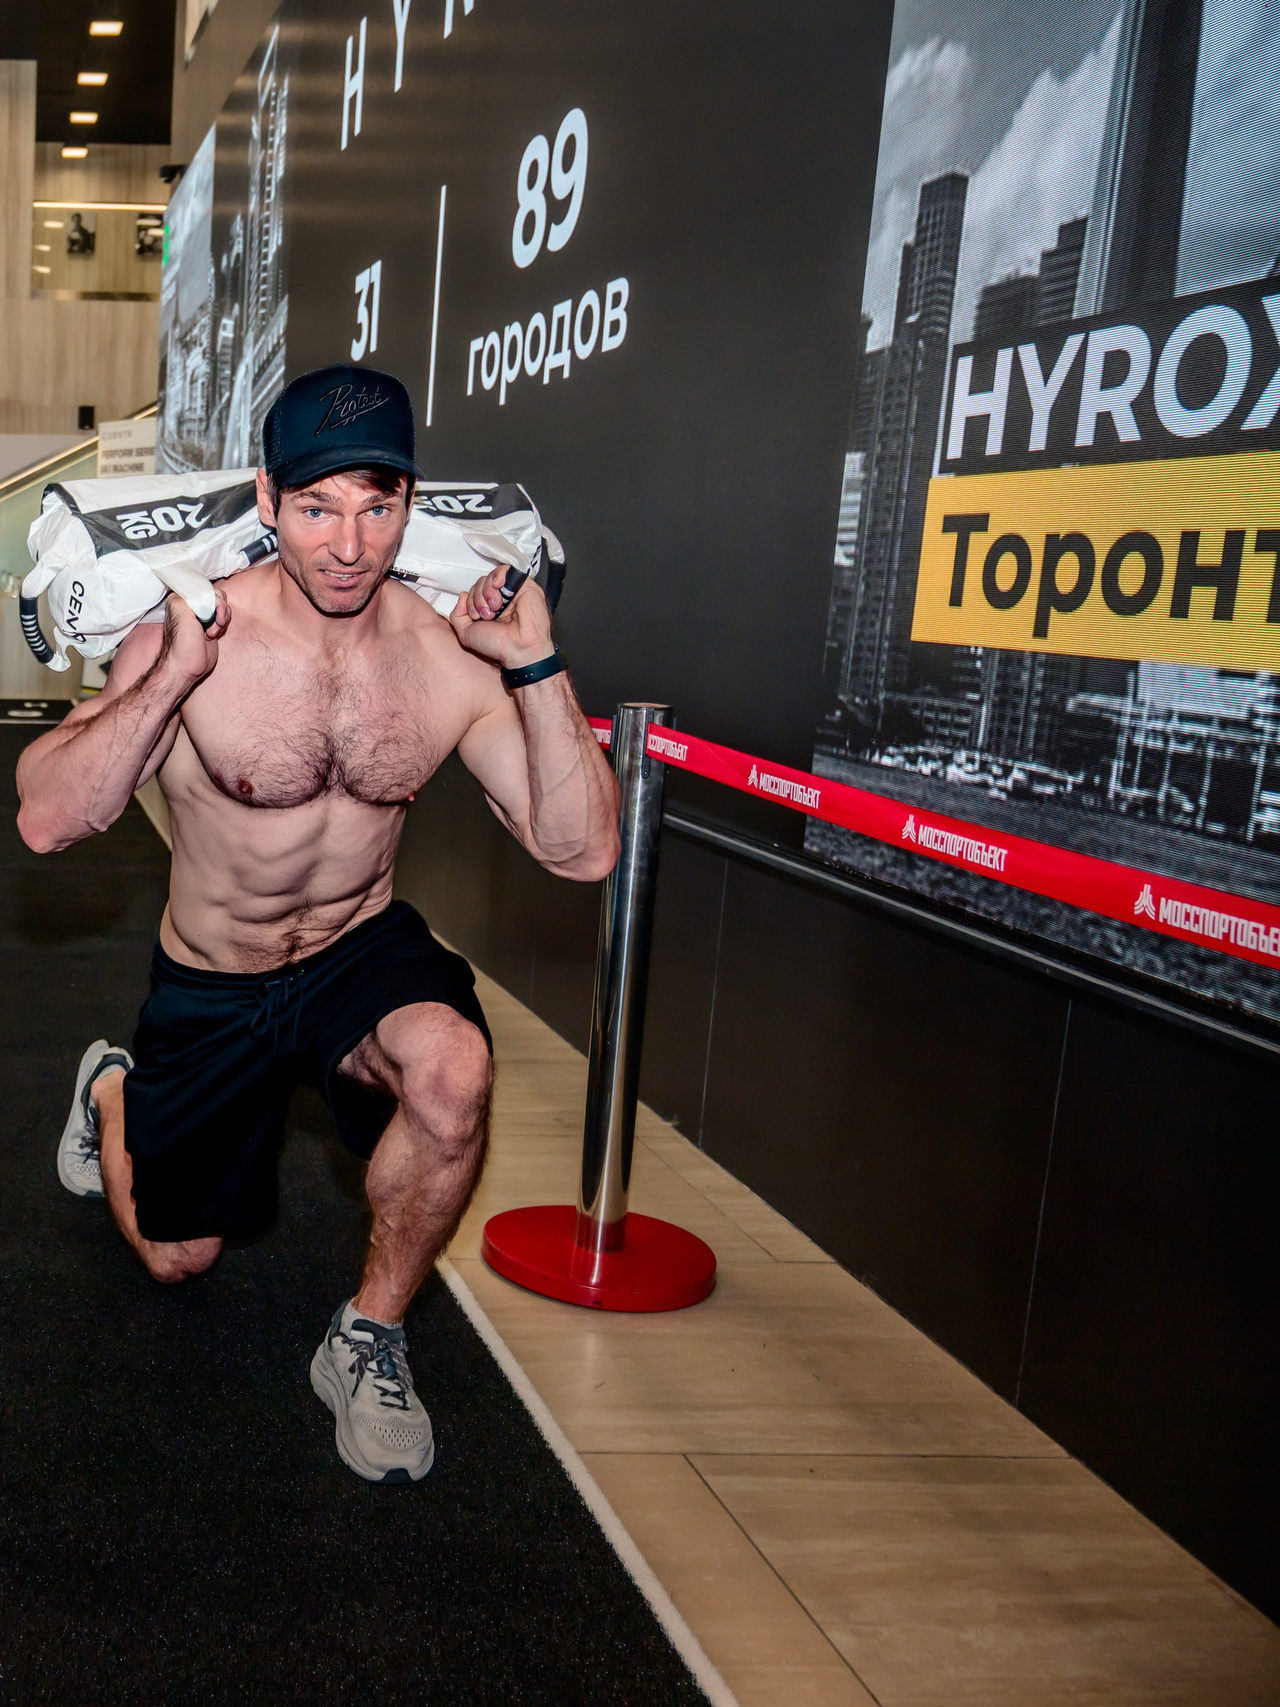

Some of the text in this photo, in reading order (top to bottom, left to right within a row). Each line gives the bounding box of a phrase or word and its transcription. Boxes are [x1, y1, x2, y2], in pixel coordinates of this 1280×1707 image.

[512, 107, 589, 269] 89
[351, 260, 382, 361] 31
[466, 277, 629, 406] городов
[115, 503, 211, 540] 20 KG
[758, 772, 821, 809] МОССПОРТОБЪЕКТ
[918, 824, 1008, 872] МОССПОРТОБЪЕКТ
